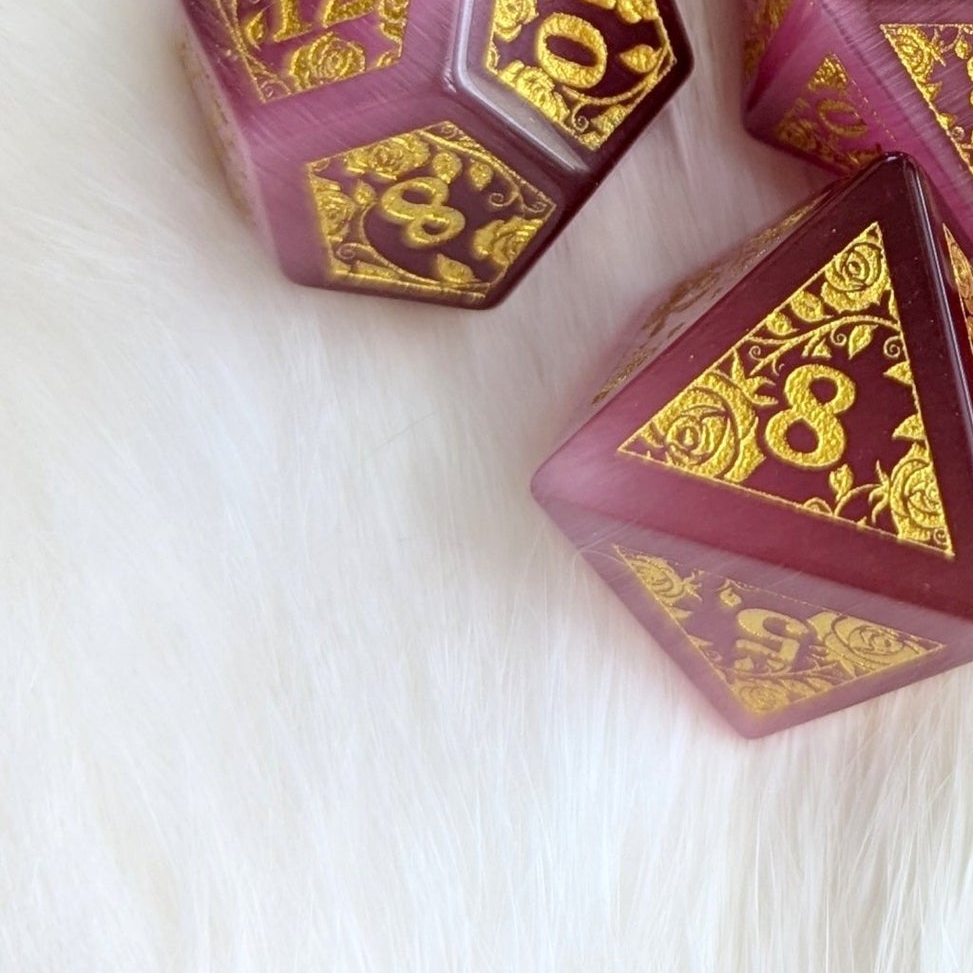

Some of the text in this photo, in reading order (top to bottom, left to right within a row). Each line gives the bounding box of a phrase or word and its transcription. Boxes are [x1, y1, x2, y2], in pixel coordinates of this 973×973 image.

[381, 176, 467, 249] 8
[764, 363, 857, 471] 8
[737, 607, 808, 673] 5
